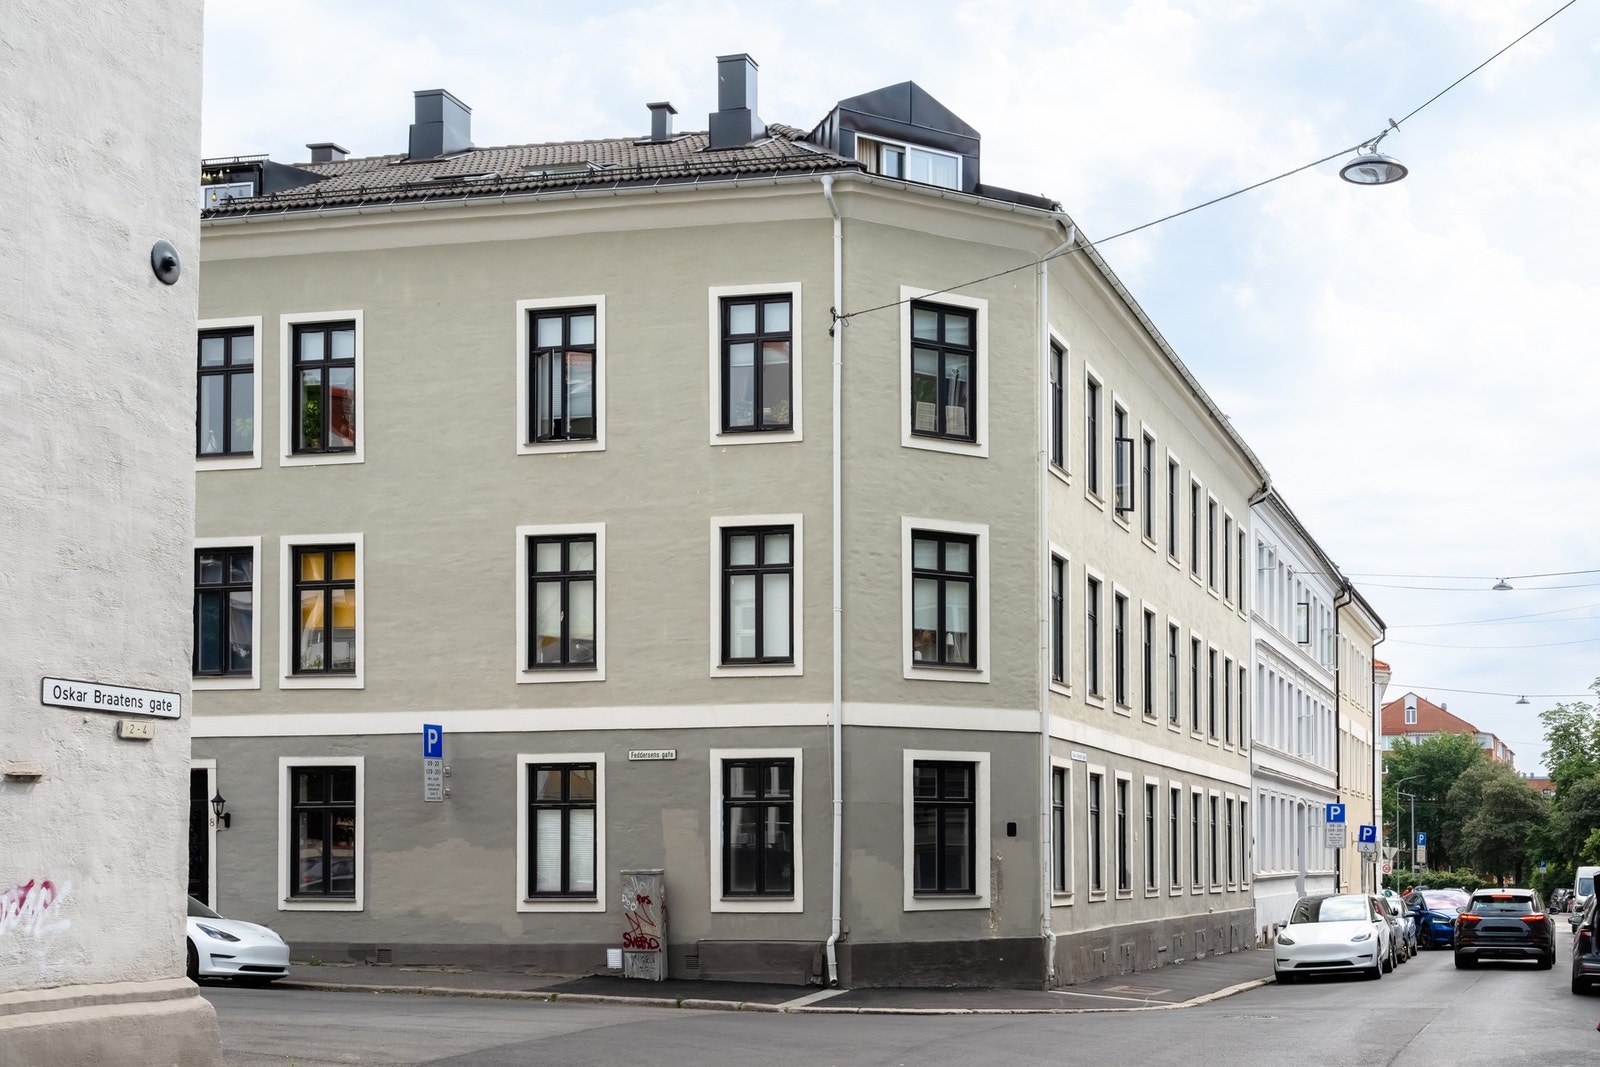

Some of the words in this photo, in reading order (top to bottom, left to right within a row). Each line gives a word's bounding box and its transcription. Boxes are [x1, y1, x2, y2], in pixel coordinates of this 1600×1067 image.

[53, 685, 87, 702] Oskar
[94, 689, 143, 709] Braatens
[149, 698, 173, 713] gate
[427, 728, 438, 753] P
[630, 751, 660, 759] Feddersens
[661, 751, 674, 760] gate
[1330, 805, 1341, 821] P
[209, 817, 215, 827] 8
[1362, 827, 1373, 841] P
[1418, 834, 1425, 844] P
